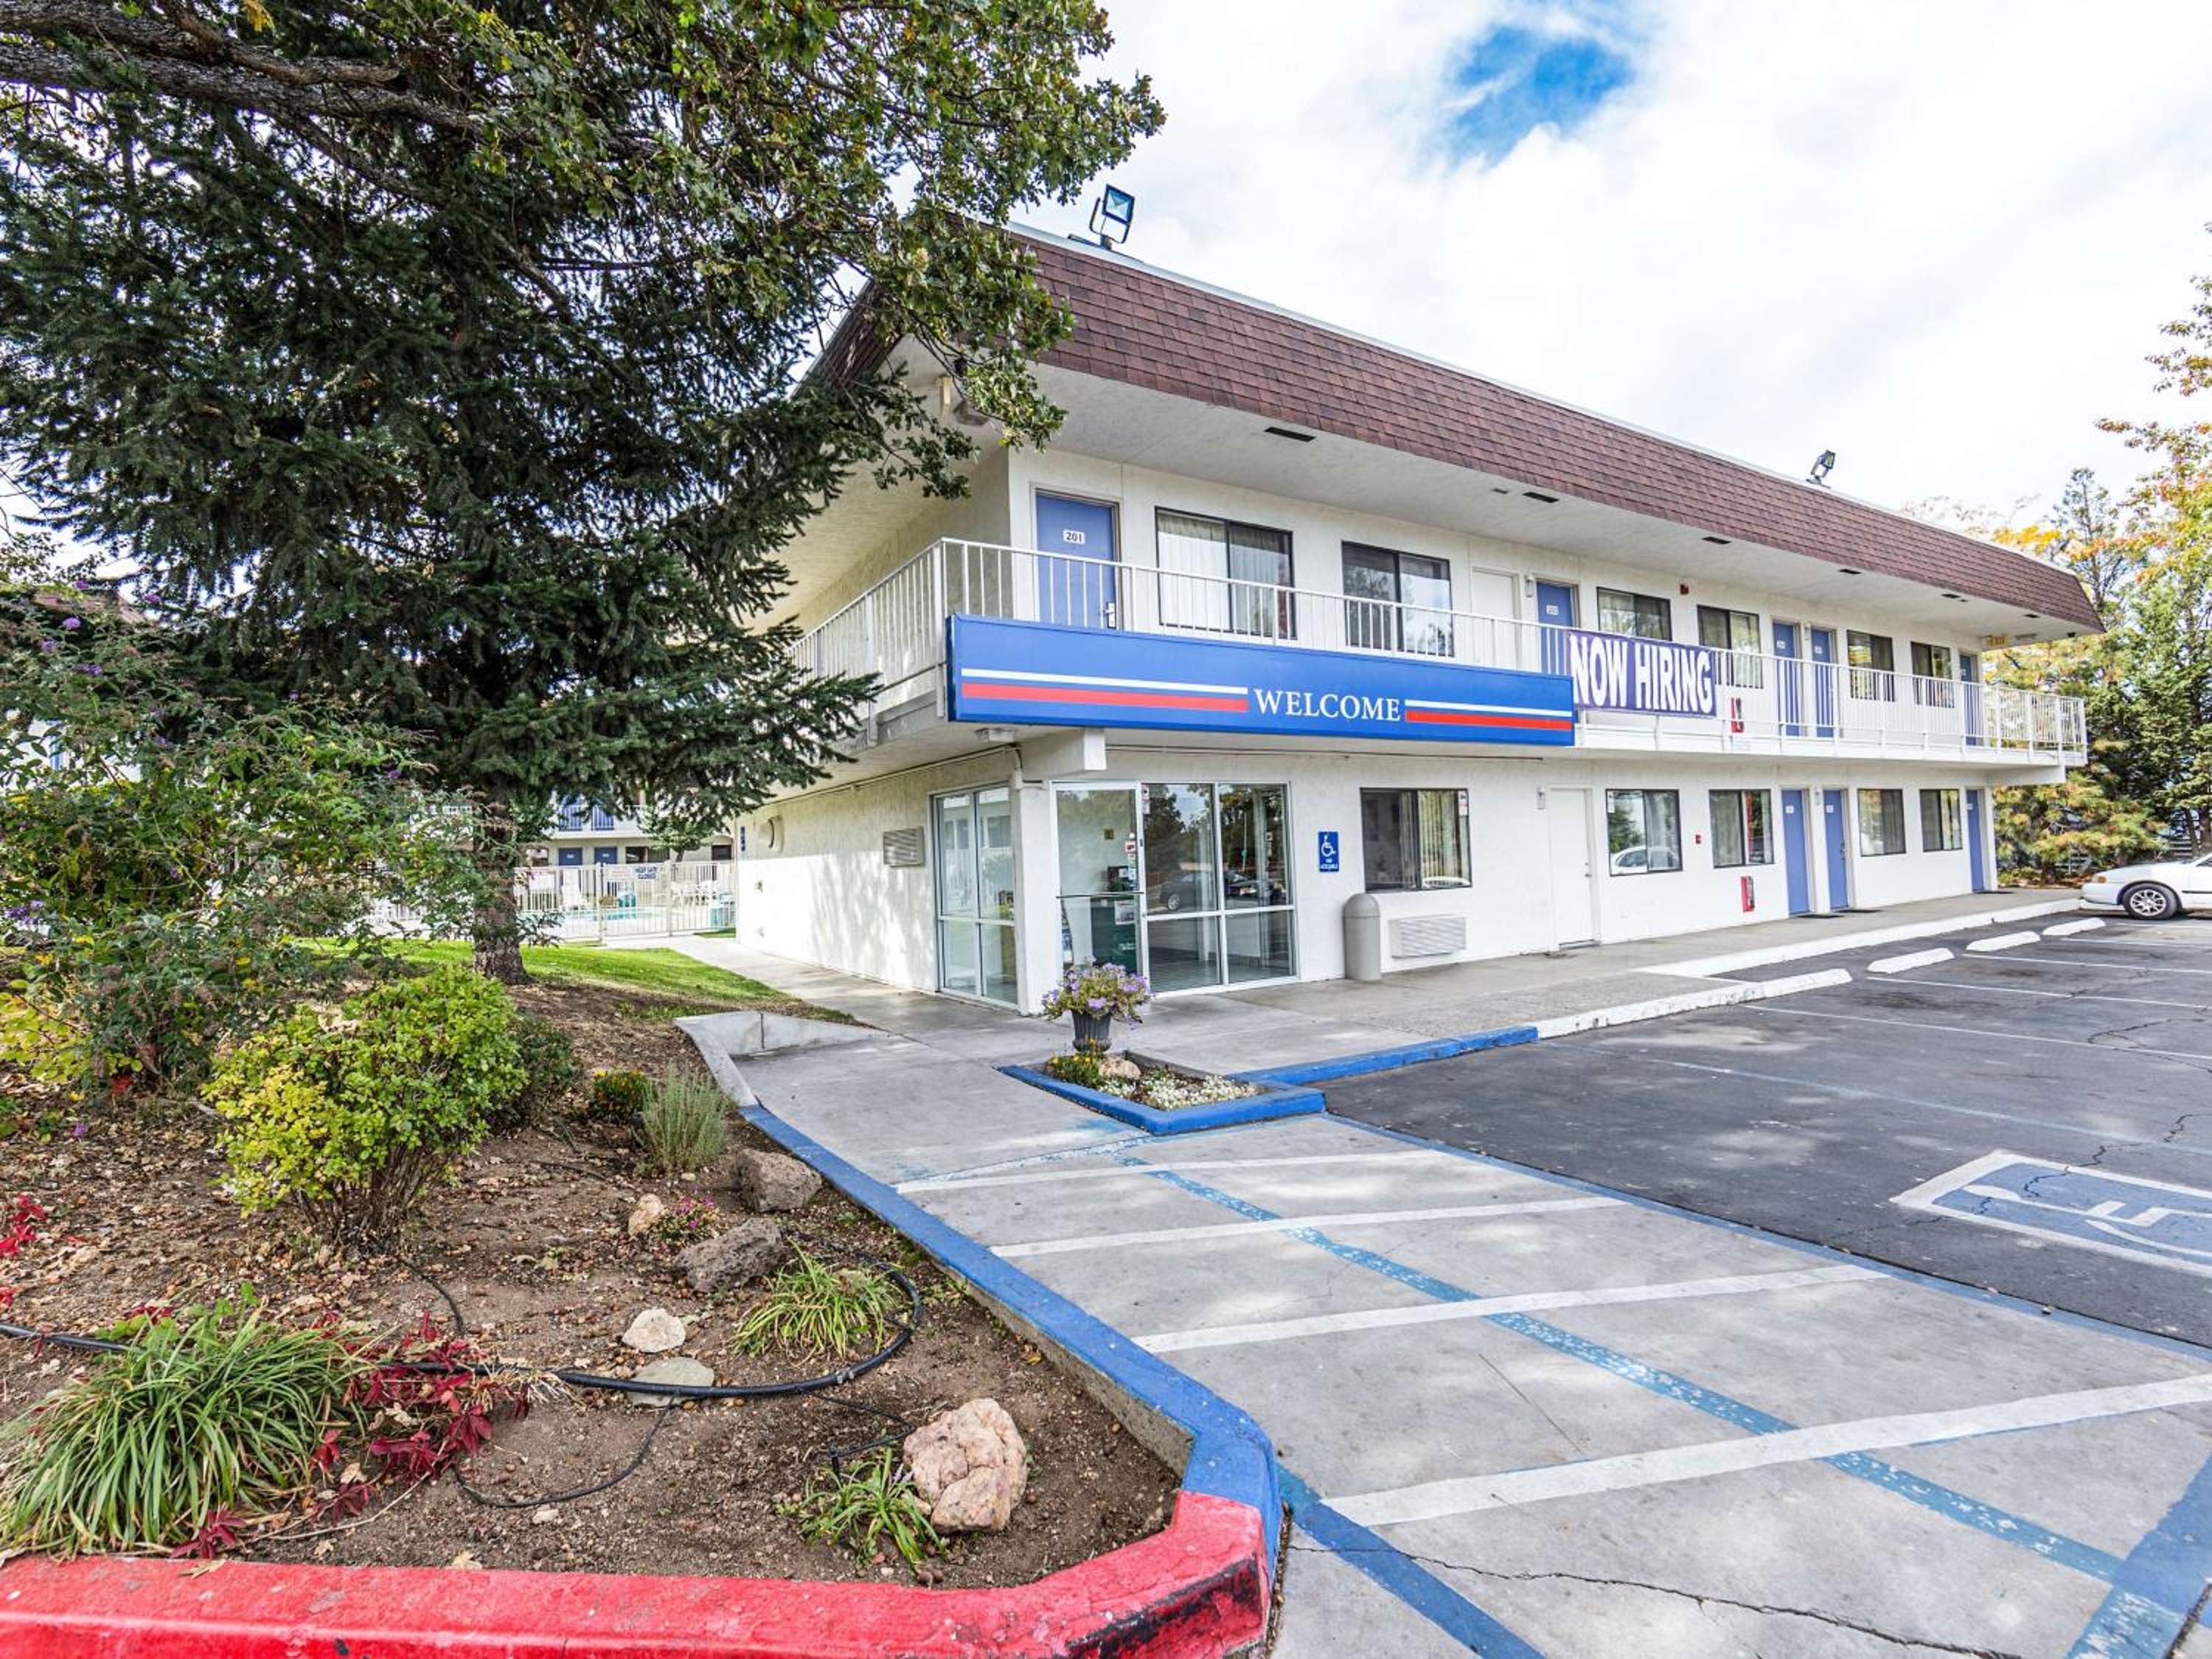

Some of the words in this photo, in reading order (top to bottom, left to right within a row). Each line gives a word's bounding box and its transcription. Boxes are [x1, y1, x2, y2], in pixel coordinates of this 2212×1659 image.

[1066, 532, 1082, 543] 201
[1570, 634, 1628, 707] NOW
[1634, 641, 1713, 714] HIRING
[1253, 689, 1402, 722] WELCOME
